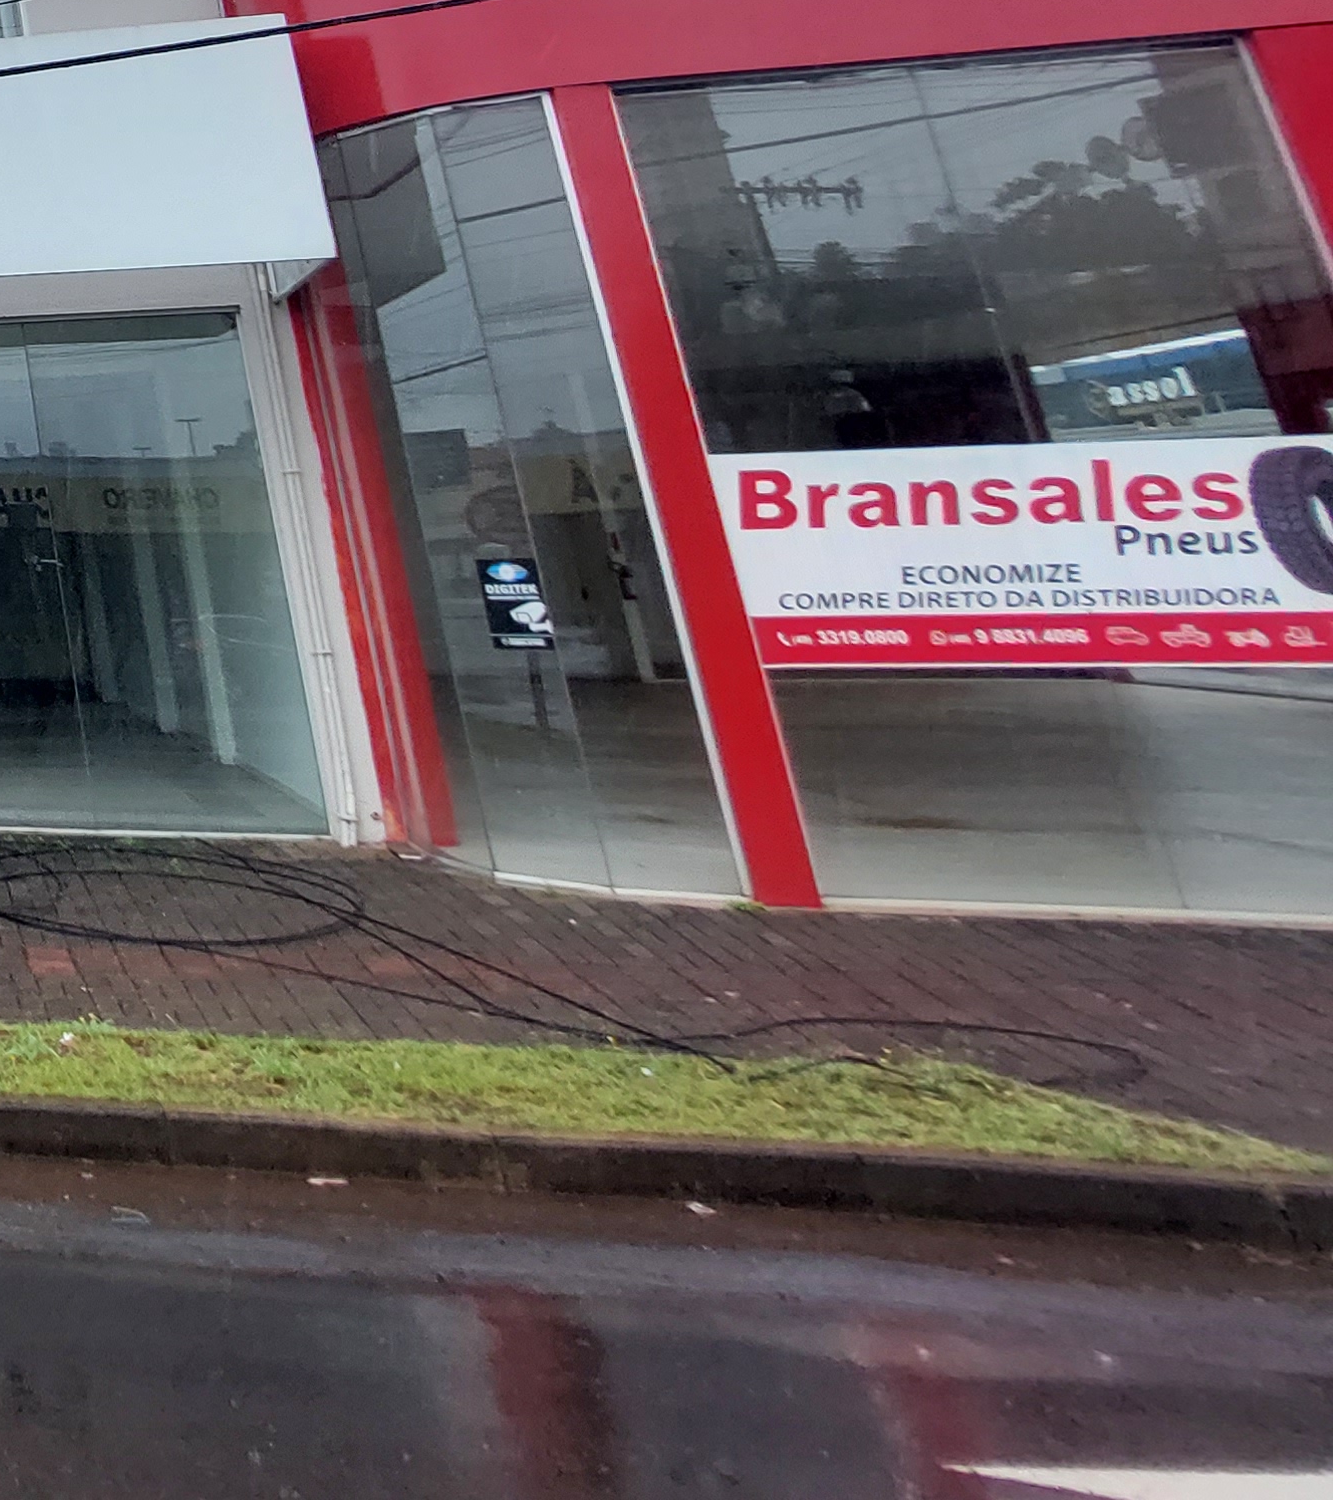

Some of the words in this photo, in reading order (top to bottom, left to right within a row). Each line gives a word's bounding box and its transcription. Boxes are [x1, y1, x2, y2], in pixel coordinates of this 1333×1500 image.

[738, 458, 1245, 530] Bransales
[1114, 524, 1260, 556] Pneus
[901, 563, 1083, 586] ECONOMIZE
[484, 583, 539, 595] DIGITEK
[778, 592, 891, 610] COMPRE
[898, 590, 997, 609] DIRETO
[1004, 589, 1045, 608] DA
[1050, 587, 1281, 608] DISTRIBUIDORA
